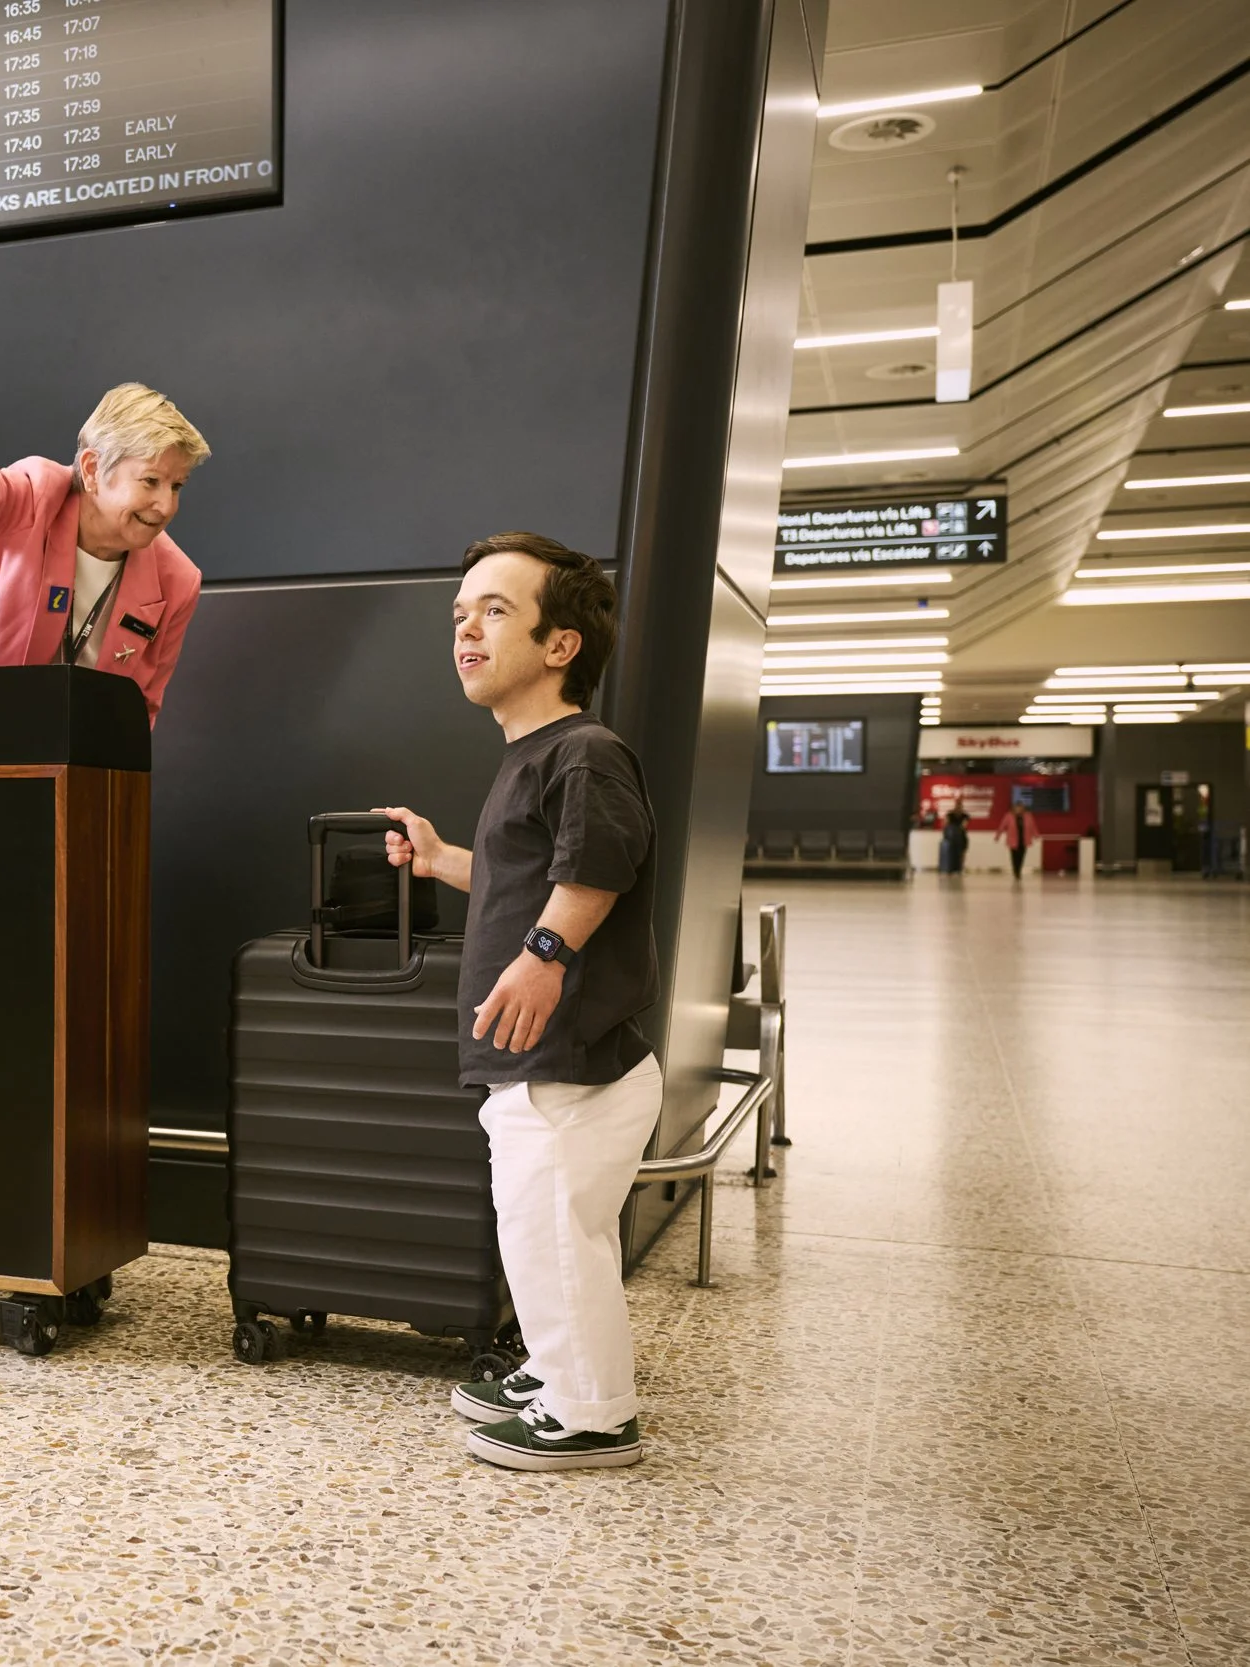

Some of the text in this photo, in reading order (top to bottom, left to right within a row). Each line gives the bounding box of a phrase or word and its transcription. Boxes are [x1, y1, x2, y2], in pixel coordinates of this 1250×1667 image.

[4, 0, 41, 18] 16:35
[4, 25, 42, 45] 16:45
[63, 16, 101, 35] 17:07
[4, 53, 40, 72] 17:25
[63, 44, 98, 63] 17:18
[4, 80, 40, 100] 17:25
[63, 71, 101, 90] 17:30
[4, 107, 40, 127] 17:35
[63, 99, 101, 117] 17:59
[4, 134, 42, 153] 17:40
[63, 126, 101, 145] 17:23
[125, 114, 177, 136] EARLY
[4, 161, 42, 181] 17:45
[63, 153, 101, 172] 17:28
[125, 142, 177, 163] EARLY
[23, 188, 61, 209] ARE
[65, 176, 155, 203] LOCATED
[159, 172, 180, 190] IN
[184, 162, 253, 187] FRONT
[257, 160, 273, 176] O
[811, 509, 879, 526] Departures
[879, 506, 900, 521] via
[798, 526, 865, 542] Departures
[865, 523, 886, 538] via
[784, 550, 851, 566] Departures
[851, 548, 872, 562] via
